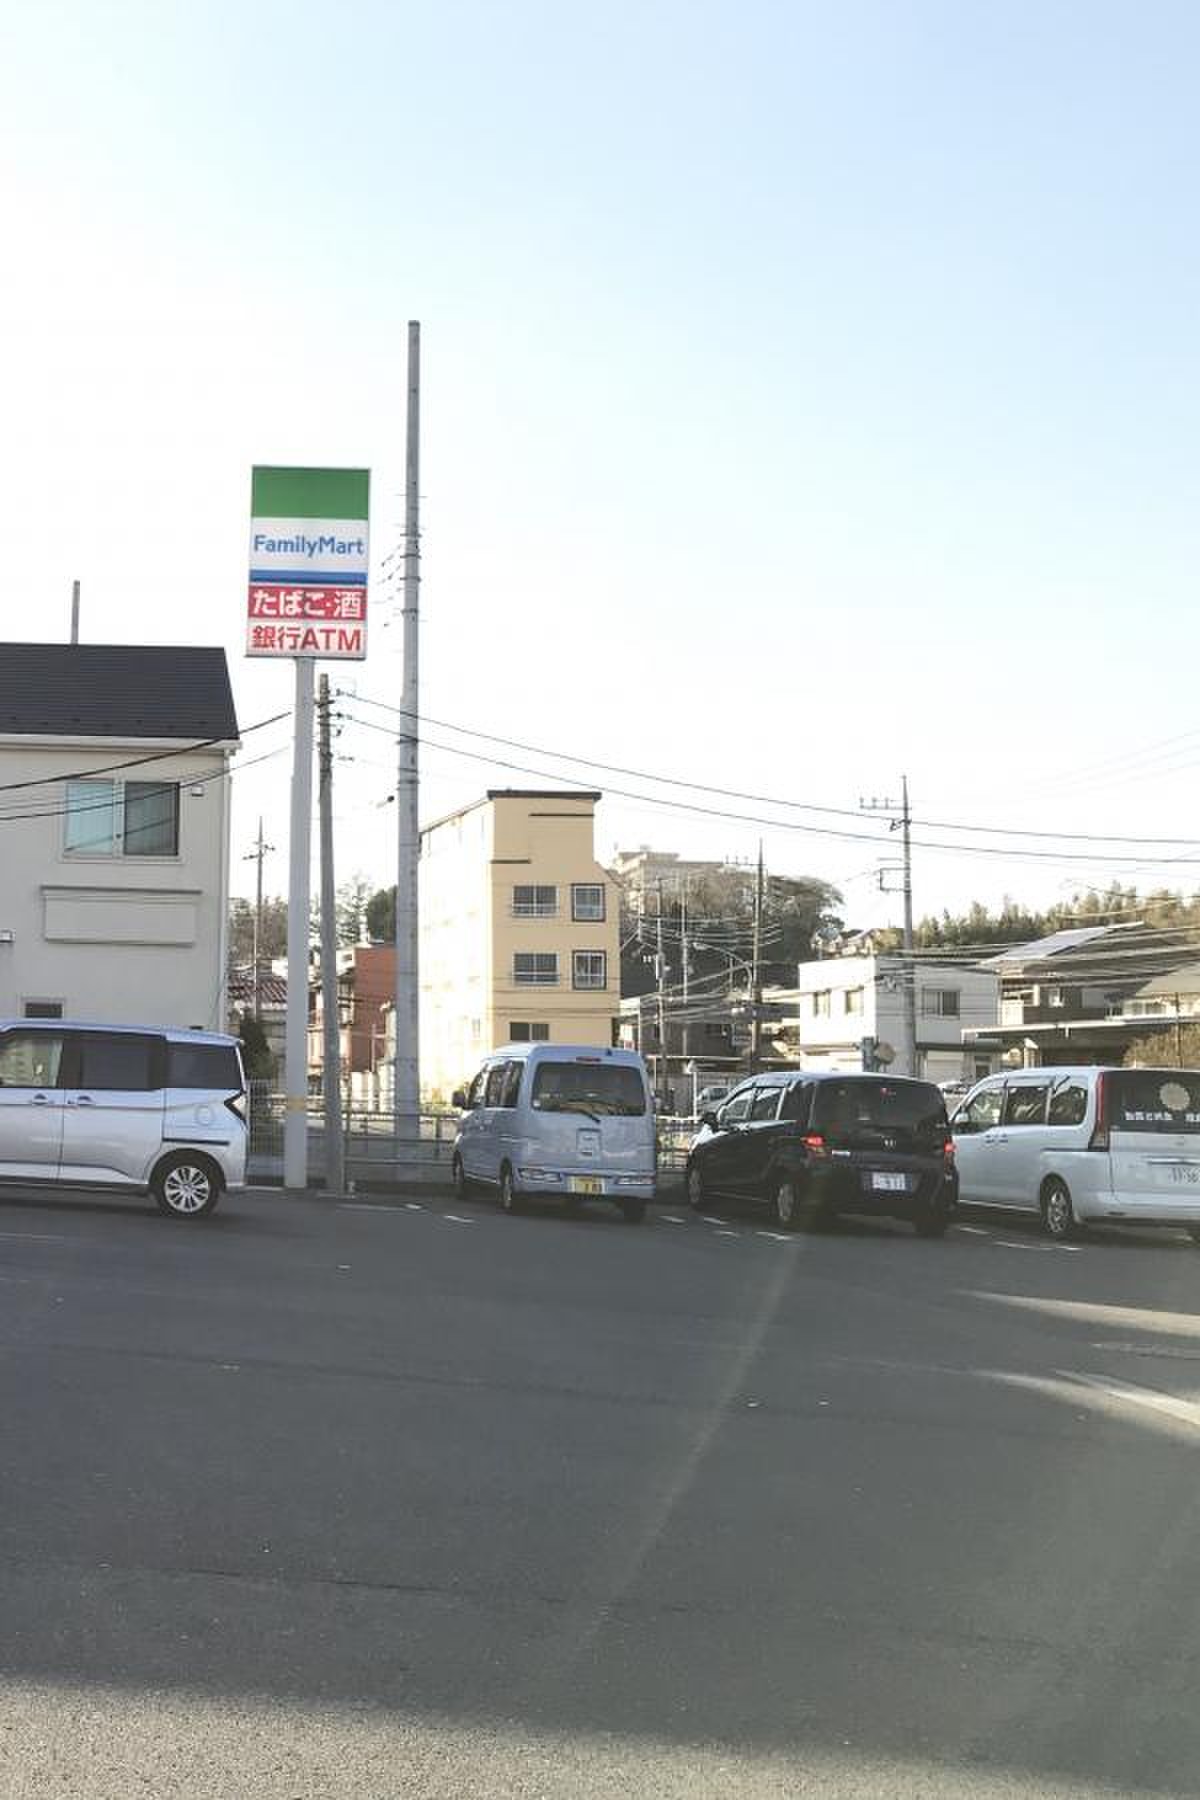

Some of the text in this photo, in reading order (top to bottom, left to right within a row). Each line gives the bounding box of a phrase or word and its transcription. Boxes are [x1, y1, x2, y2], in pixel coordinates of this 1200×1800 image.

[254, 534, 364, 558] FamilyMart
[253, 590, 363, 618] たばこ・酒
[252, 625, 361, 651] 銀行ATM
